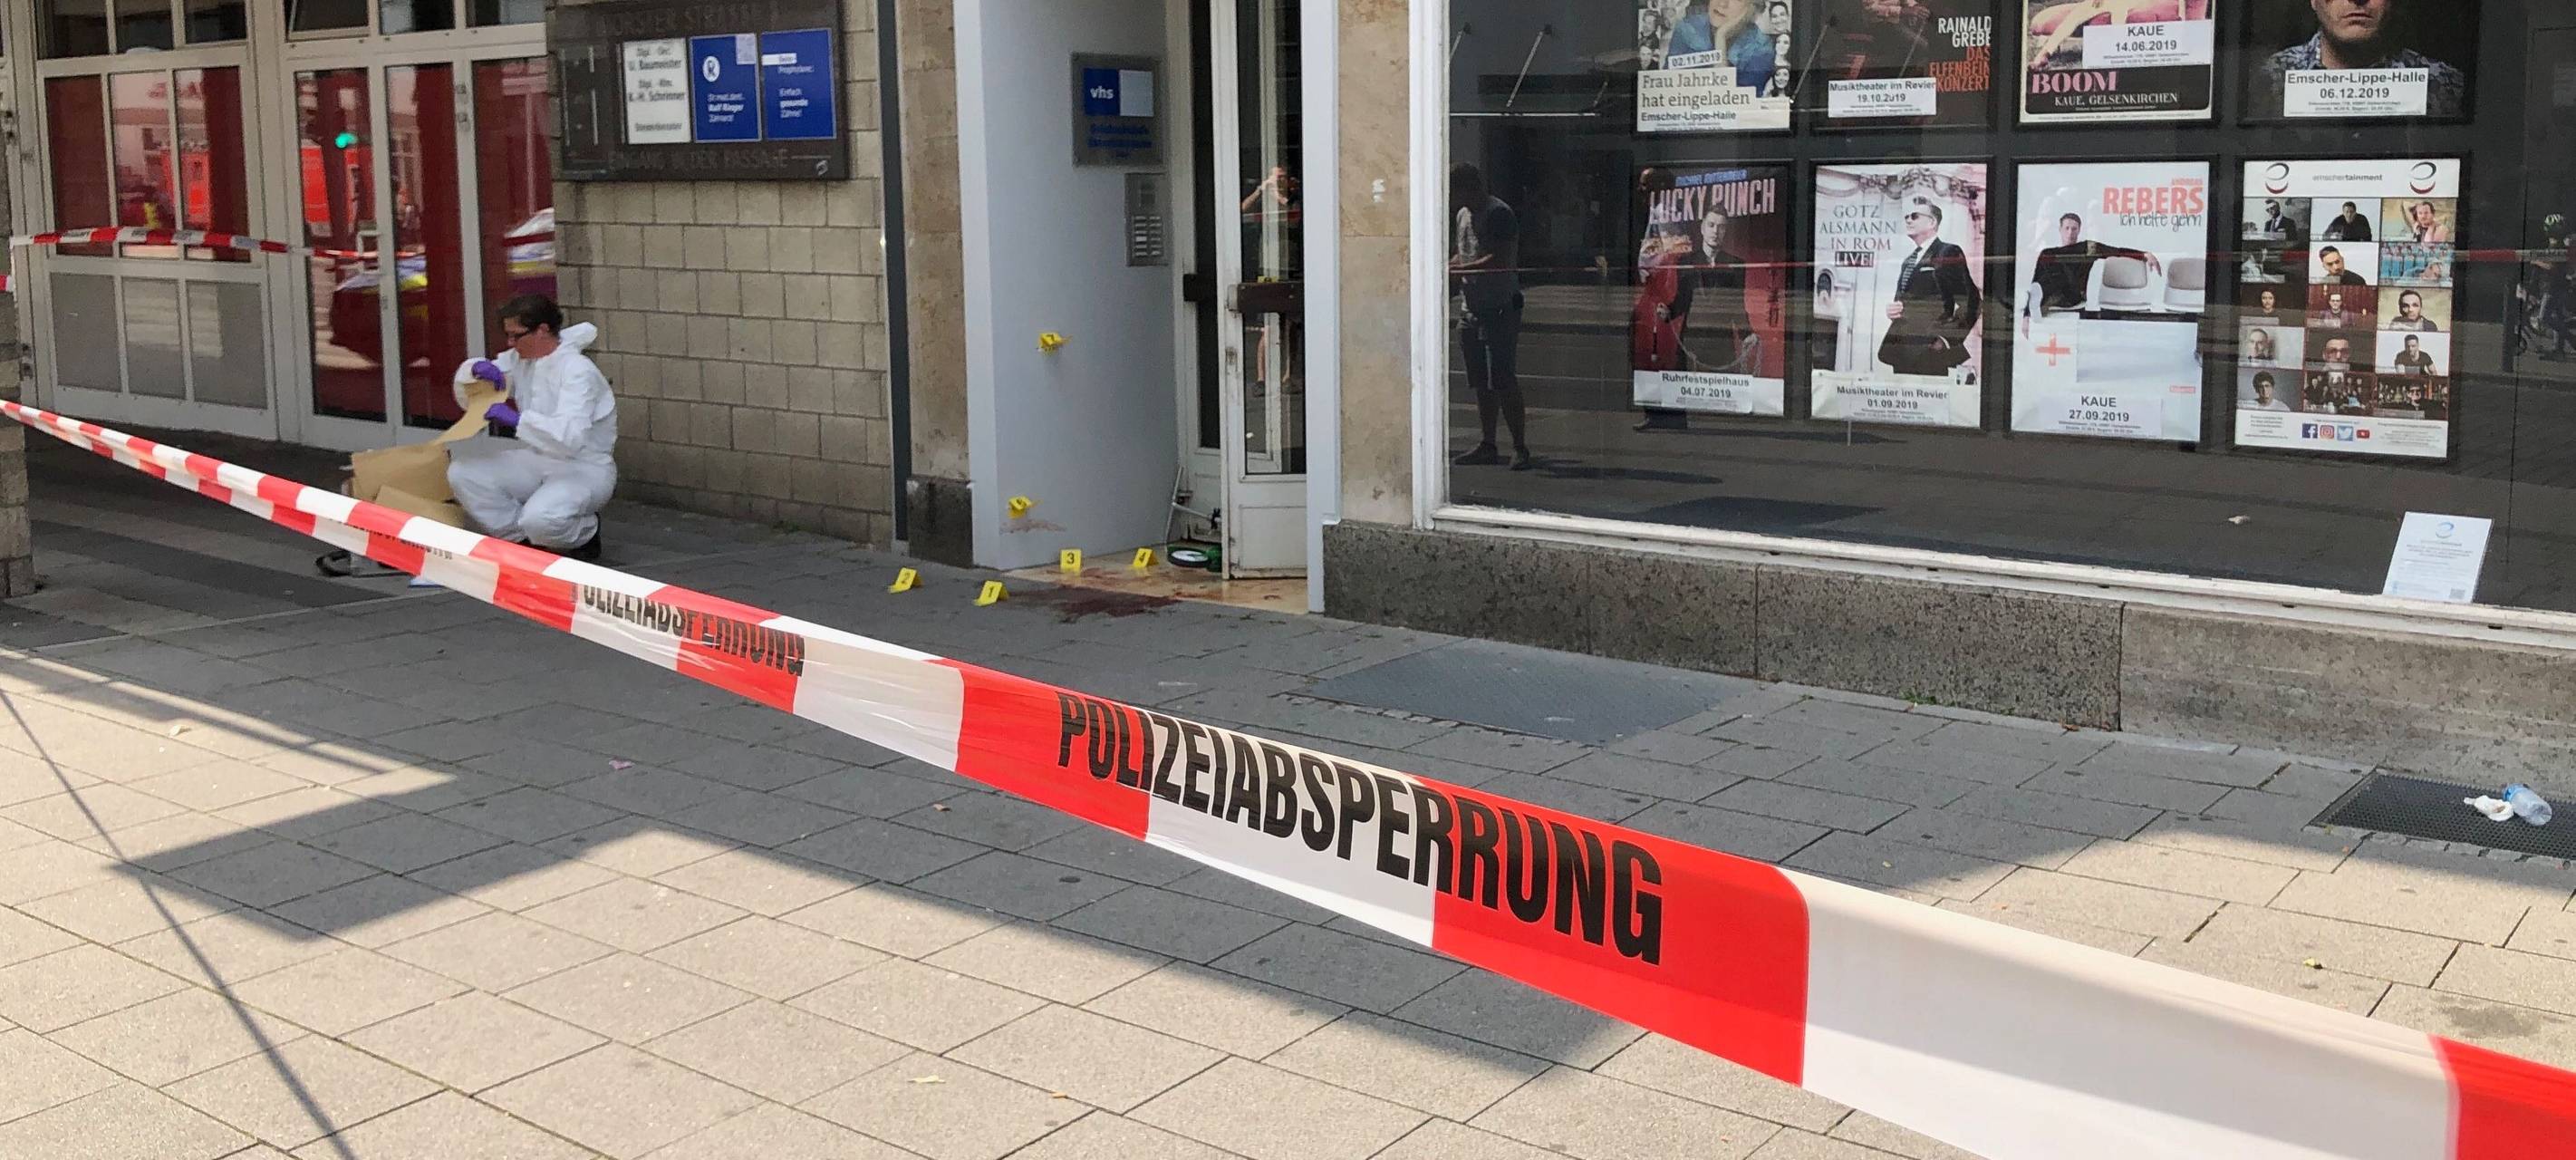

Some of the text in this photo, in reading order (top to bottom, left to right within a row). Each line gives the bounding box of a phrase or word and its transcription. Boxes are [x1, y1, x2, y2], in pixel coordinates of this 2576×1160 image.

[1938, 15, 1992, 34] RAINALD
[2127, 24, 2165, 37] KAUE
[1952, 31, 1991, 47] GREBE
[2115, 39, 2177, 53] 14.06.2019
[1672, 52, 1721, 67] 02.11.2019
[1966, 46, 1991, 61] DAS
[1642, 72, 1728, 88] Frau Jahnke
[2031, 71, 2118, 94] BOOM
[2287, 71, 2426, 85] Emscher-Lippe-Halle
[1090, 85, 1114, 100] vhs
[1829, 80, 1936, 92] Musiktheater im Revier
[2320, 87, 2390, 99] 06.12.2019
[1642, 91, 1751, 110] hat eingeladen
[1857, 93, 1906, 102] 19.10.2019
[2089, 92, 2179, 106] GELSENKIRCHEN
[1641, 111, 1737, 122] Emscher-Lippe-Halle
[1649, 178, 1775, 224] LUCKY PUNCH
[2102, 187, 2204, 214] REBERS
[1819, 220, 1897, 234] ALSMANN
[2119, 209, 2202, 232] Ich helfe gern
[1831, 237, 1891, 250] IN ROM
[1836, 252, 1874, 266] LIVE!
[1662, 372, 1750, 387] Ruhrfestspielhaus
[1680, 386, 1732, 399] 04.07.2019
[1837, 386, 1947, 399] Musiktheater im Revier
[1867, 399, 1918, 410] 01.09.2019
[2081, 395, 2117, 408] KAUE
[2069, 410, 2129, 421] 27.09.2019
[1066, 552, 1076, 565] 3
[1138, 552, 1146, 563] 4
[902, 572, 912, 585] 2
[986, 586, 995, 598] 1
[1056, 691, 1663, 966] POLIZEIABSPERRUNG
